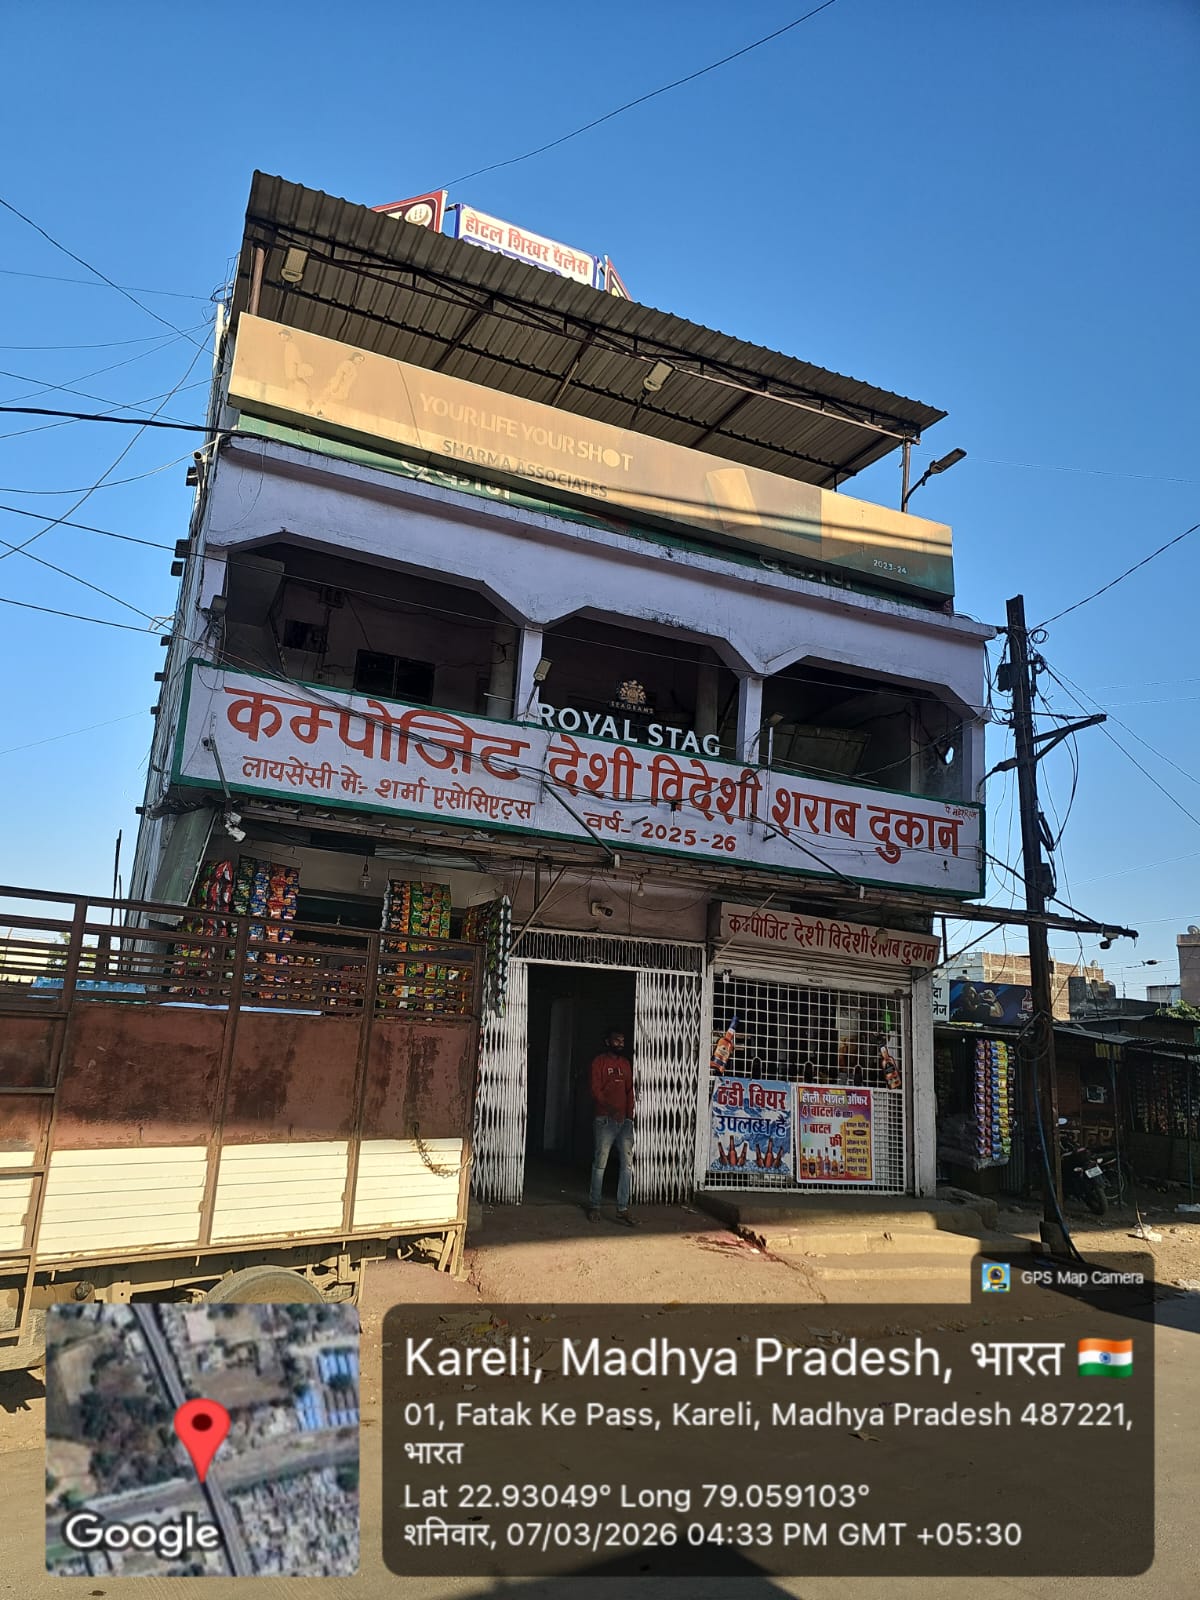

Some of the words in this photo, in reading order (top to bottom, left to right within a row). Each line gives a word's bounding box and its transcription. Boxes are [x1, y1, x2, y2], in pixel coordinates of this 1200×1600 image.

[465, 211, 505, 245] होटल
[508, 226, 550, 263] शिखर
[419, 393, 479, 426] YOUR
[480, 413, 519, 440] LIFE
[520, 422, 576, 456] YOUR
[576, 440, 635, 472] SHOT
[442, 438, 511, 471] SHARMA
[516, 461, 609, 499] ASSOCIATES
[872, 559, 908, 575] 2023-24
[537, 703, 638, 743] ROYAL
[647, 723, 721, 757] STAG
[242, 755, 339, 789] लायसेंसी
[374, 776, 431, 803] शर्मा
[547, 733, 642, 803] देशी
[647, 753, 763, 825] विदेशी
[771, 787, 862, 839] शराब
[866, 805, 963, 865] दुकान
[640, 822, 737, 852] 2025-26
[791, 916, 828, 949] देशी
[828, 923, 871, 955] विदेशी
[901, 940, 938, 966] दुकान
[717, 1080, 745, 1107] ठंडी
[748, 1082, 788, 1110] बियर
[802, 1104, 809, 1119] 4
[715, 1115, 772, 1135] उपलब्ध
[775, 1113, 787, 1138] है
